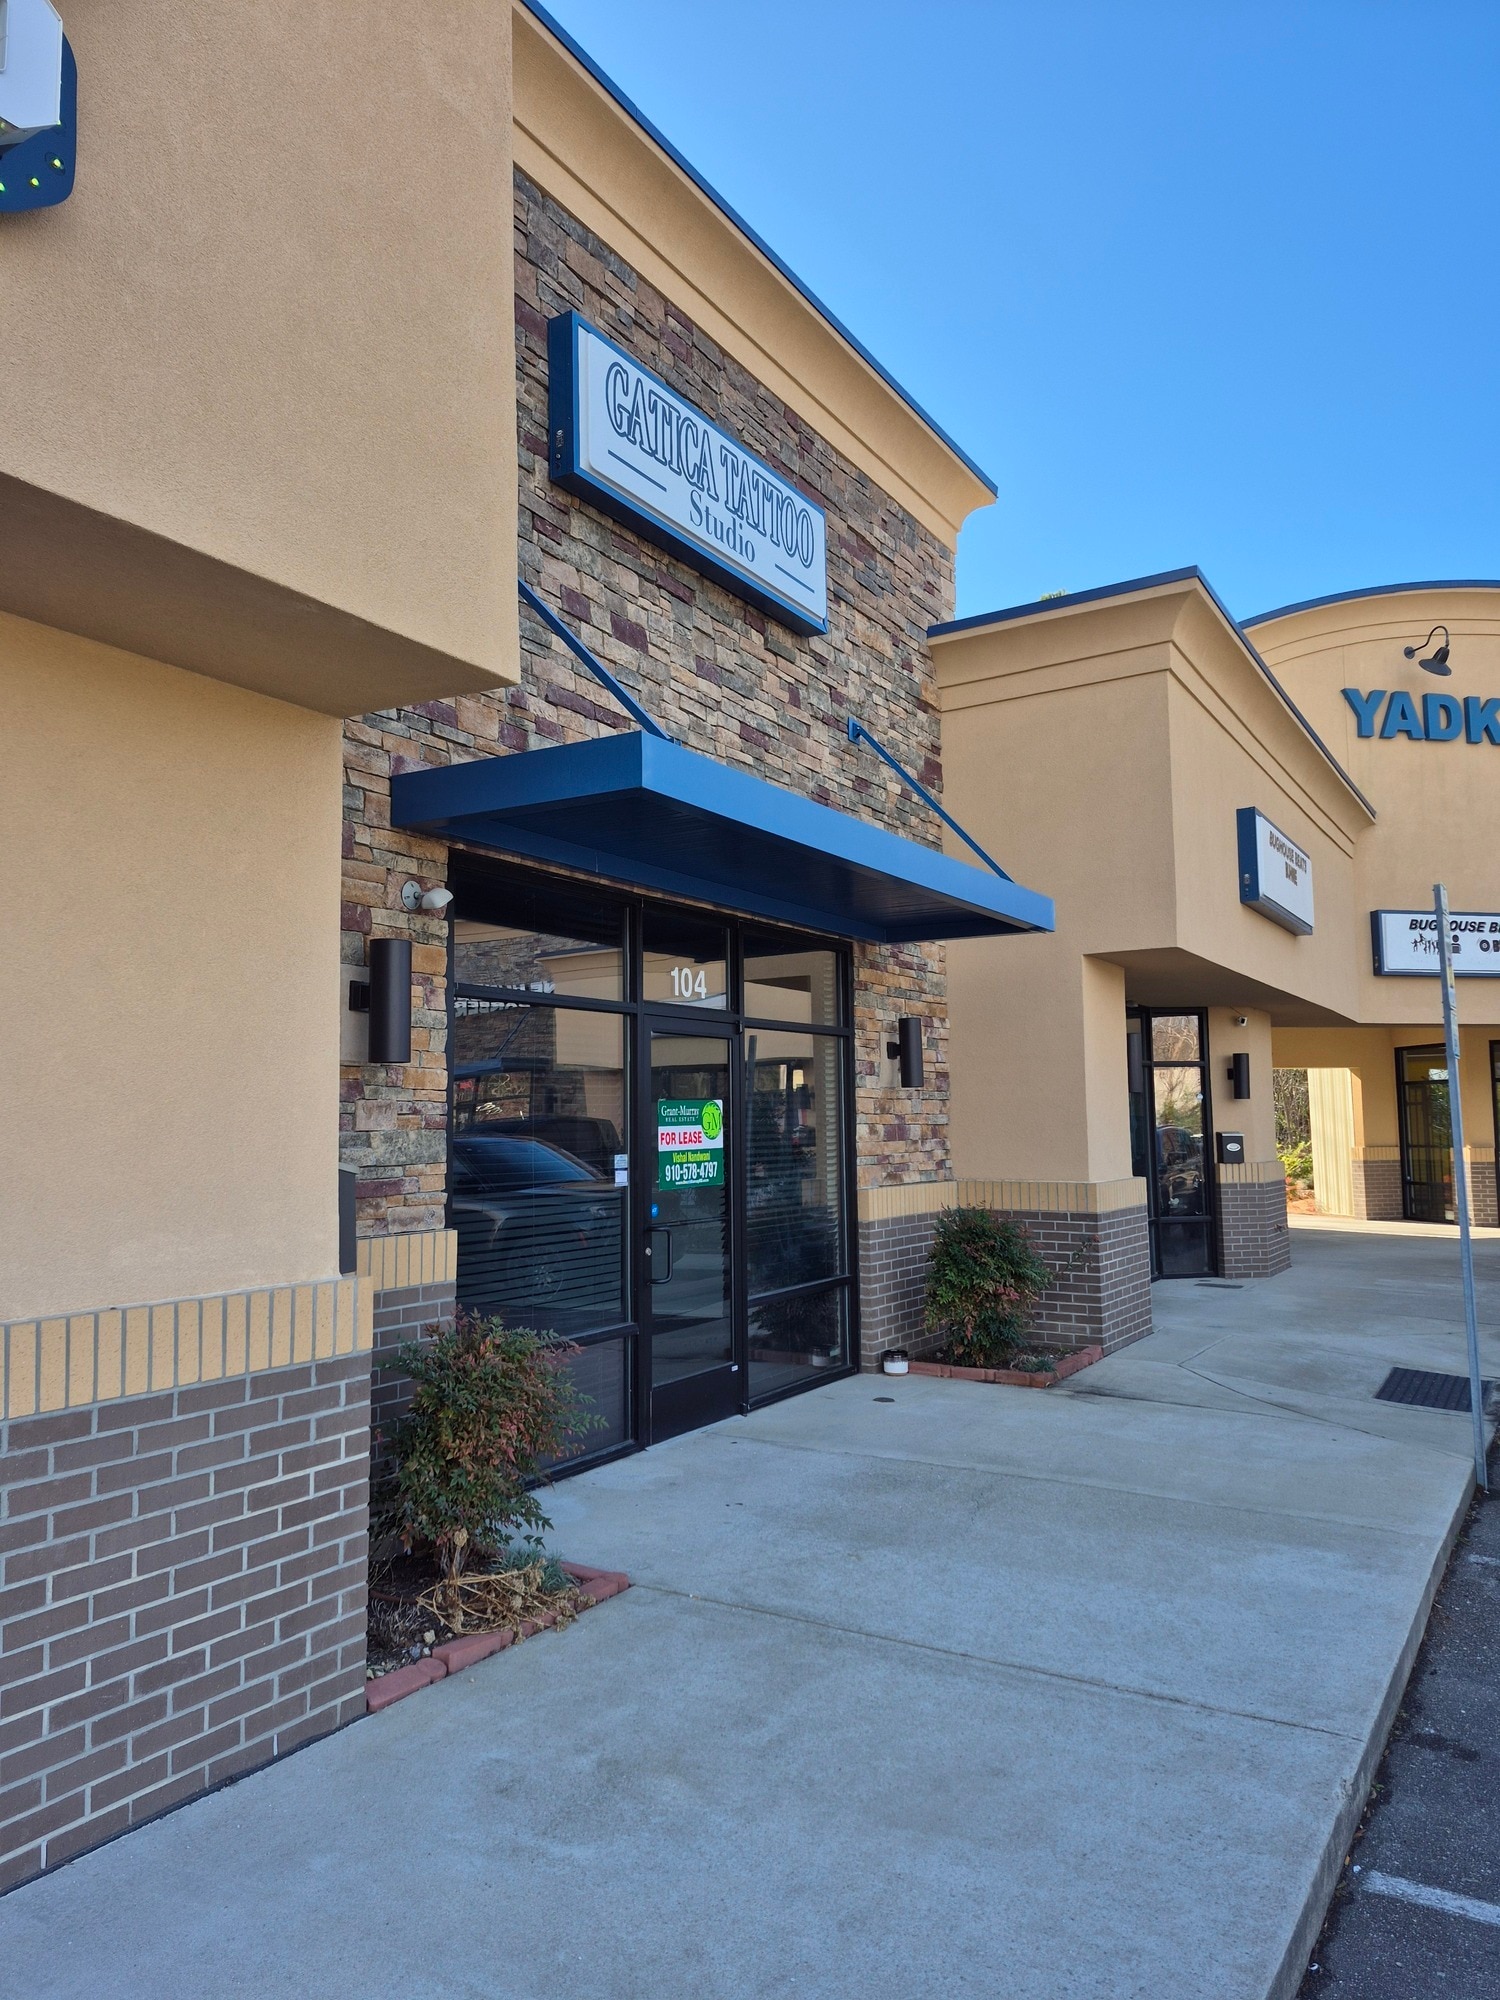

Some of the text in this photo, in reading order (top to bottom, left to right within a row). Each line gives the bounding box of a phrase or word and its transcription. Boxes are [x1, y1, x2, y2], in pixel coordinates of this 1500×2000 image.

[605, 361, 815, 569] GATICA TATTOO
[689, 489, 756, 563] Studio
[1340, 687, 1500, 746] YADK
[1408, 918, 1500, 934] BUGOUSE B
[670, 966, 708, 1000] 104
[660, 1131, 702, 1145] FOR LEASE
[665, 1162, 718, 1181] 910-578-4797
